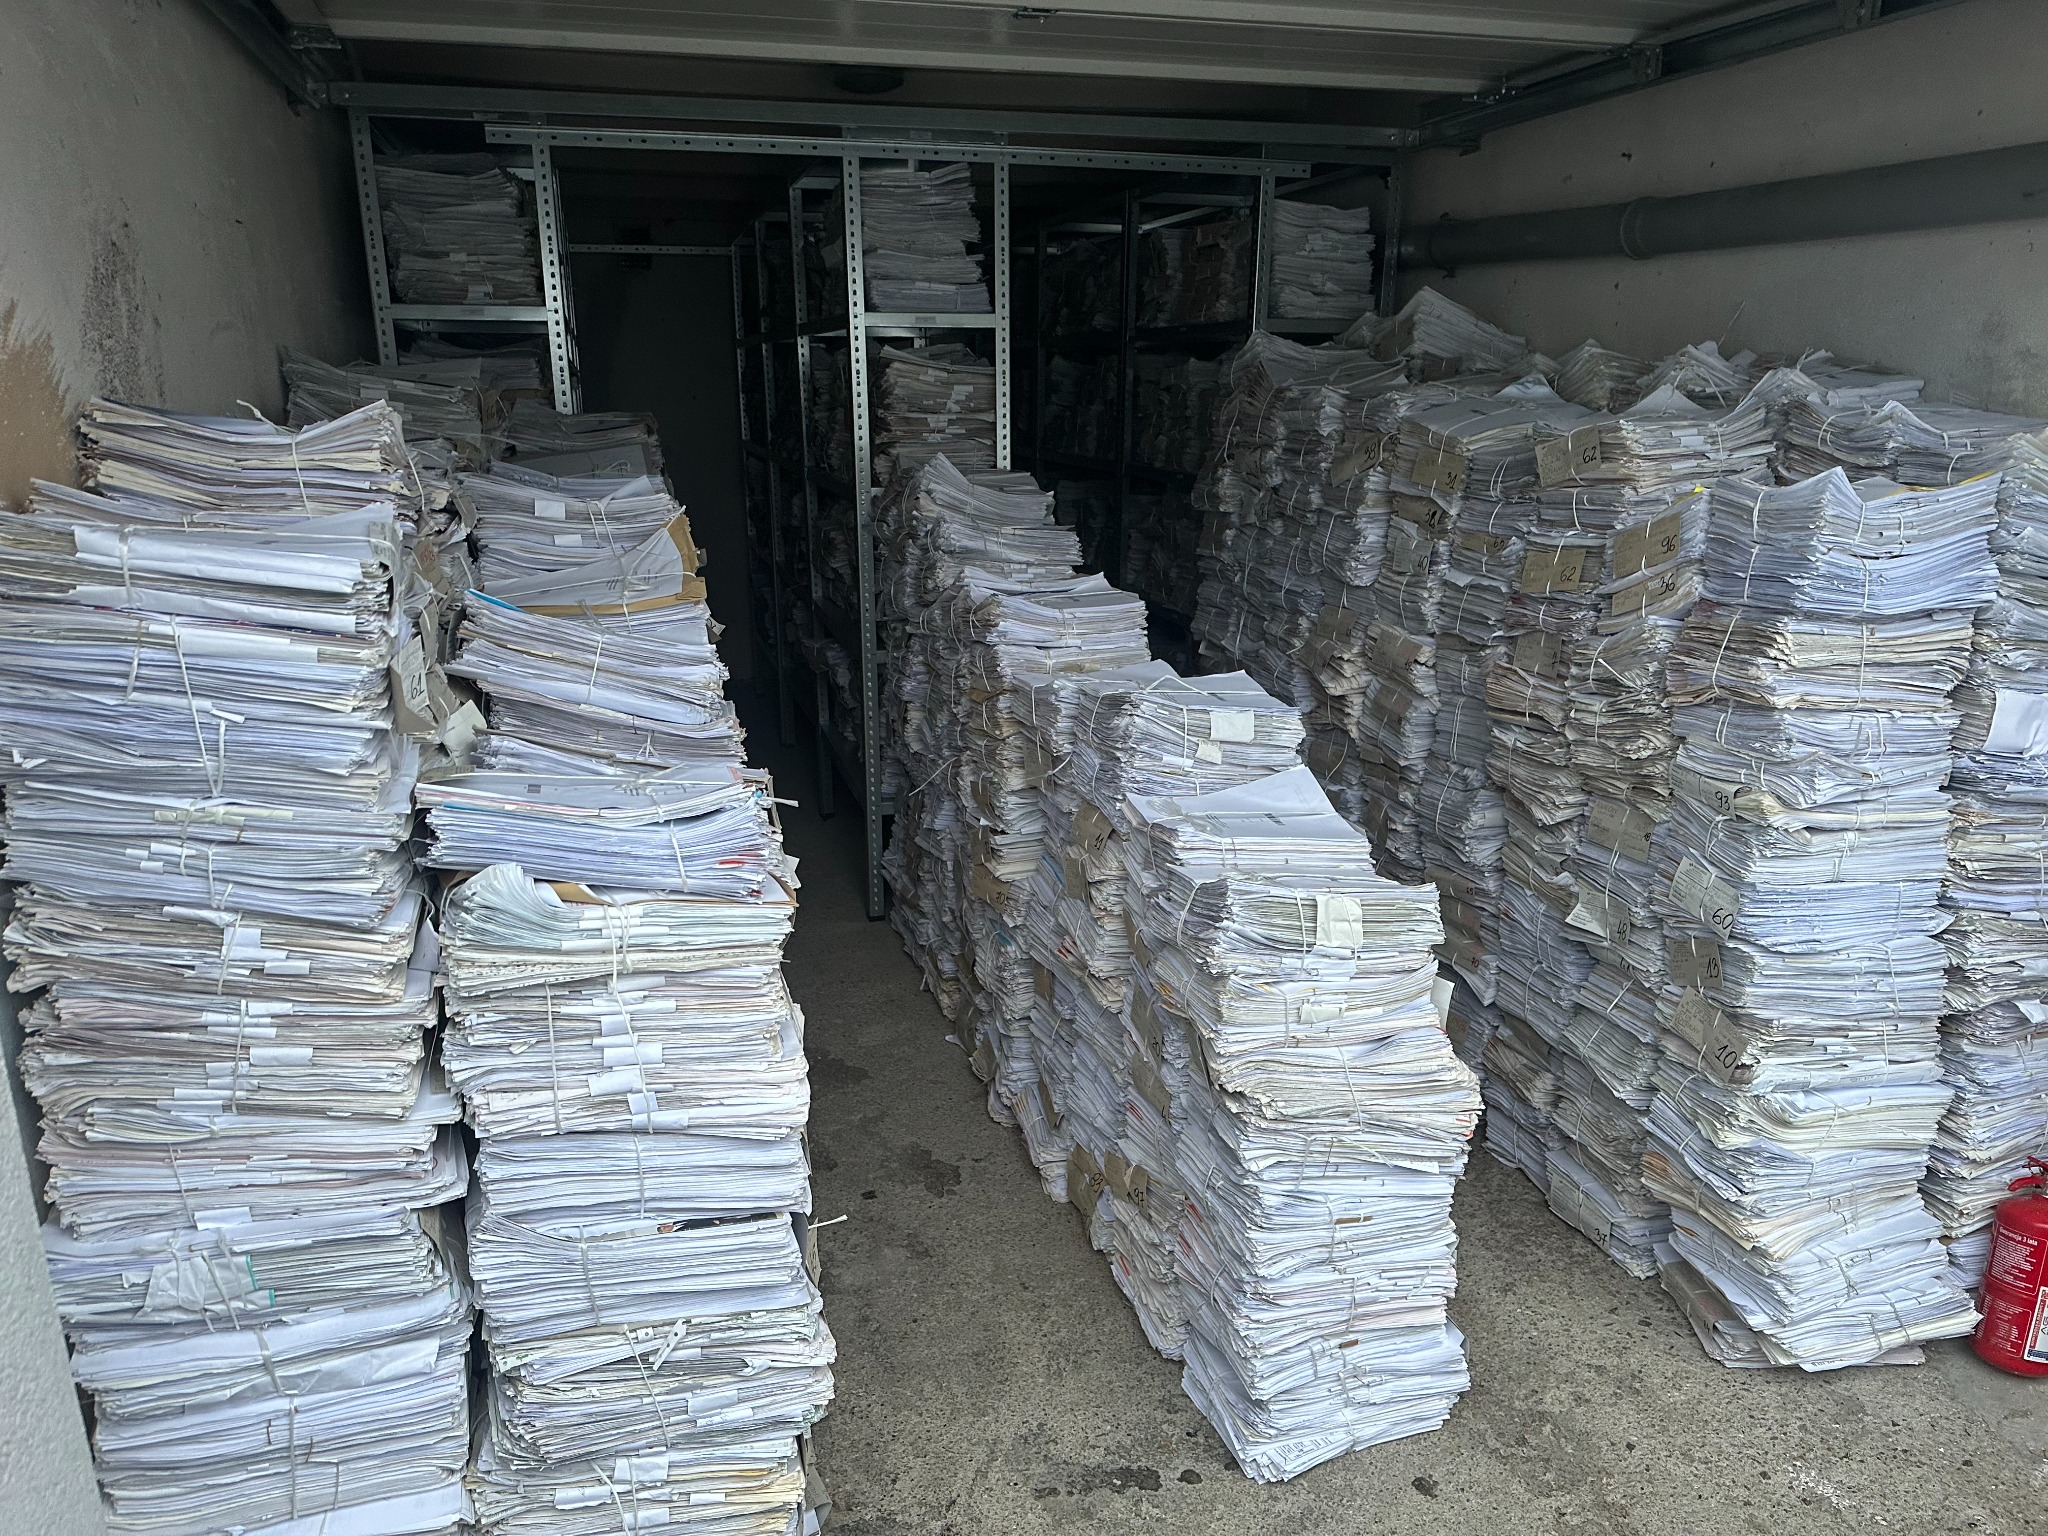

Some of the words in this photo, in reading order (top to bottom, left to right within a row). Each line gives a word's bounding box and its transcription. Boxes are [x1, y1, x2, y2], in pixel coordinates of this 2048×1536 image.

[1582, 445, 1597, 464] 62
[1445, 471, 1458, 489] 31
[1661, 534, 1678, 554] 96
[1417, 554, 1429, 571] 40
[1560, 566, 1577, 582] 62
[410, 672, 424, 700] 61
[1715, 790, 1730, 811] 93
[1711, 907, 1734, 930] 60
[1617, 921, 1627, 941] 48
[1706, 957, 1719, 978] 13
[1714, 1044, 1738, 1069] 10
[1594, 1227, 1607, 1246] 37
[1999, 1226, 2022, 1242] Gwarancja
[2022, 1234, 2027, 1243] 3
[2027, 1236, 2038, 1246] lata
